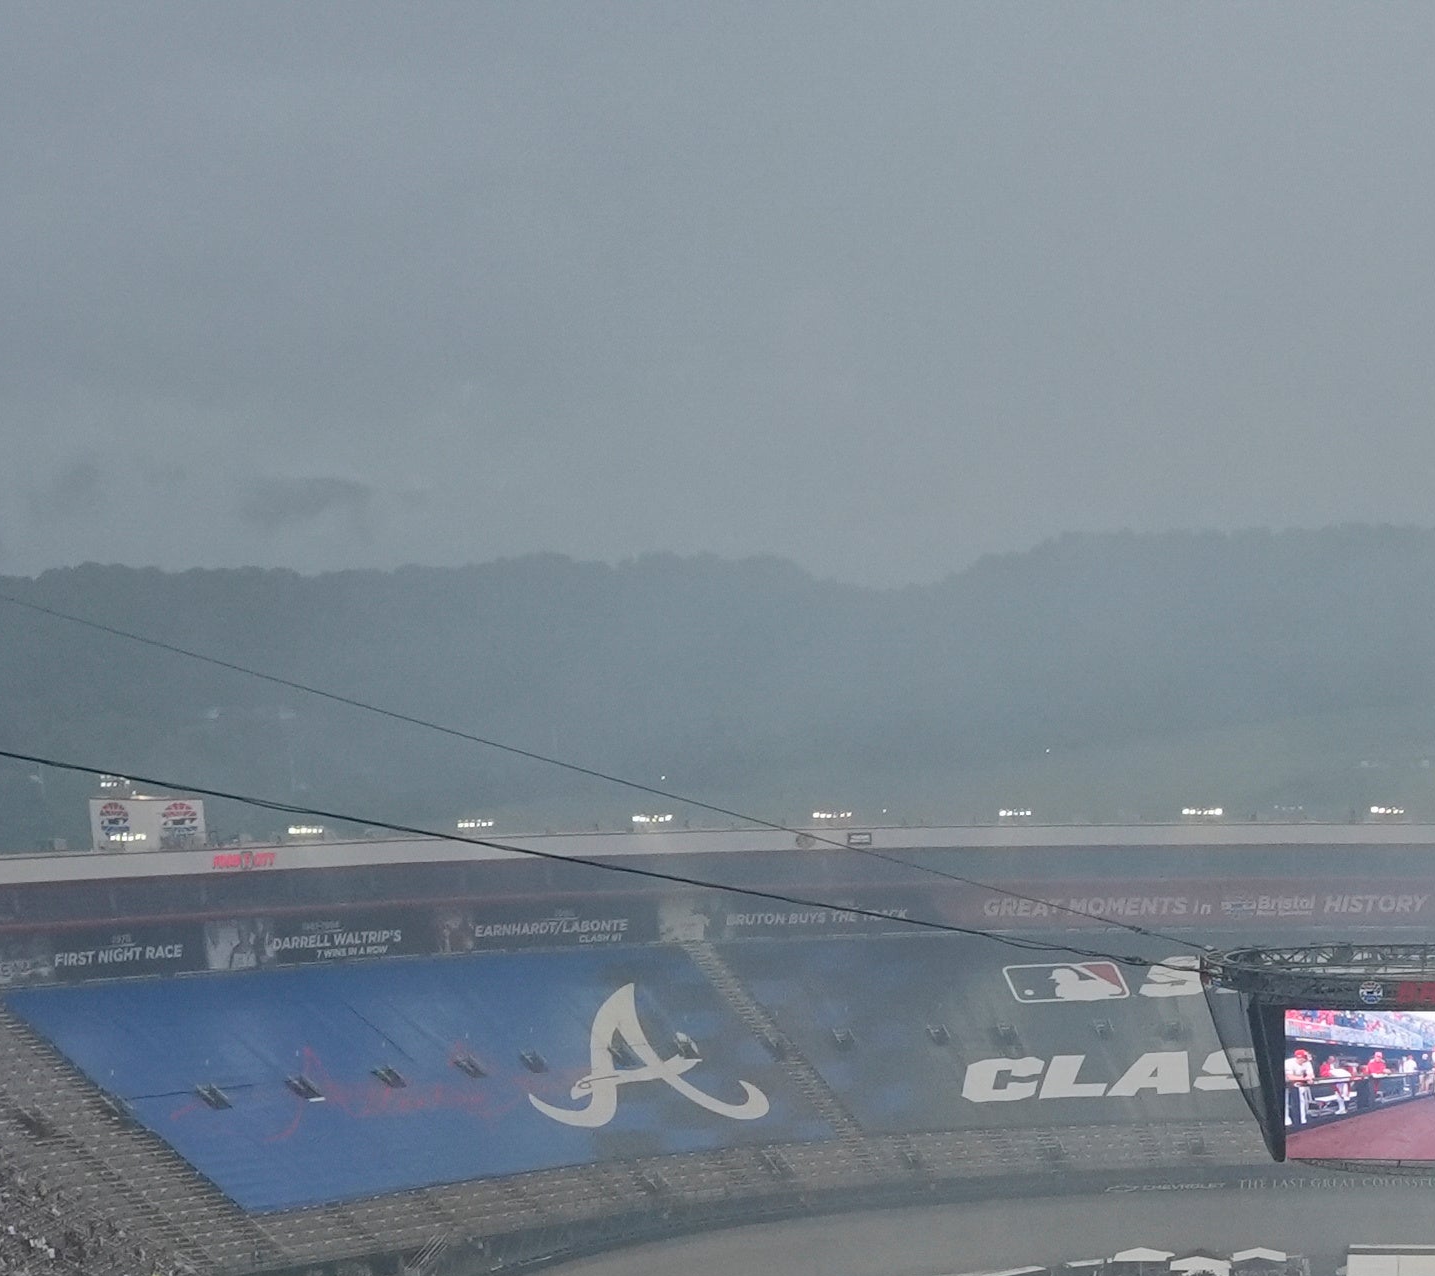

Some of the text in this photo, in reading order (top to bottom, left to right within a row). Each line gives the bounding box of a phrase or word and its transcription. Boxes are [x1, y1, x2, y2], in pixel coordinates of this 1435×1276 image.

[253, 852, 276, 867] CITY
[984, 898, 1061, 917] GREAT
[1066, 897, 1189, 917] MOMENTS
[1255, 895, 1316, 911] Bristol
[1323, 895, 1428, 914] HISTORY
[473, 918, 629, 939] EARNHARDT/LABONTE
[725, 912, 786, 926] BRUTON
[788, 911, 826, 924] BUYS
[272, 929, 402, 952] DARRELL WALTRIP'S
[54, 944, 183, 967] FIRST NIGHT RACE
[961, 1049, 1261, 1103] CLAS
